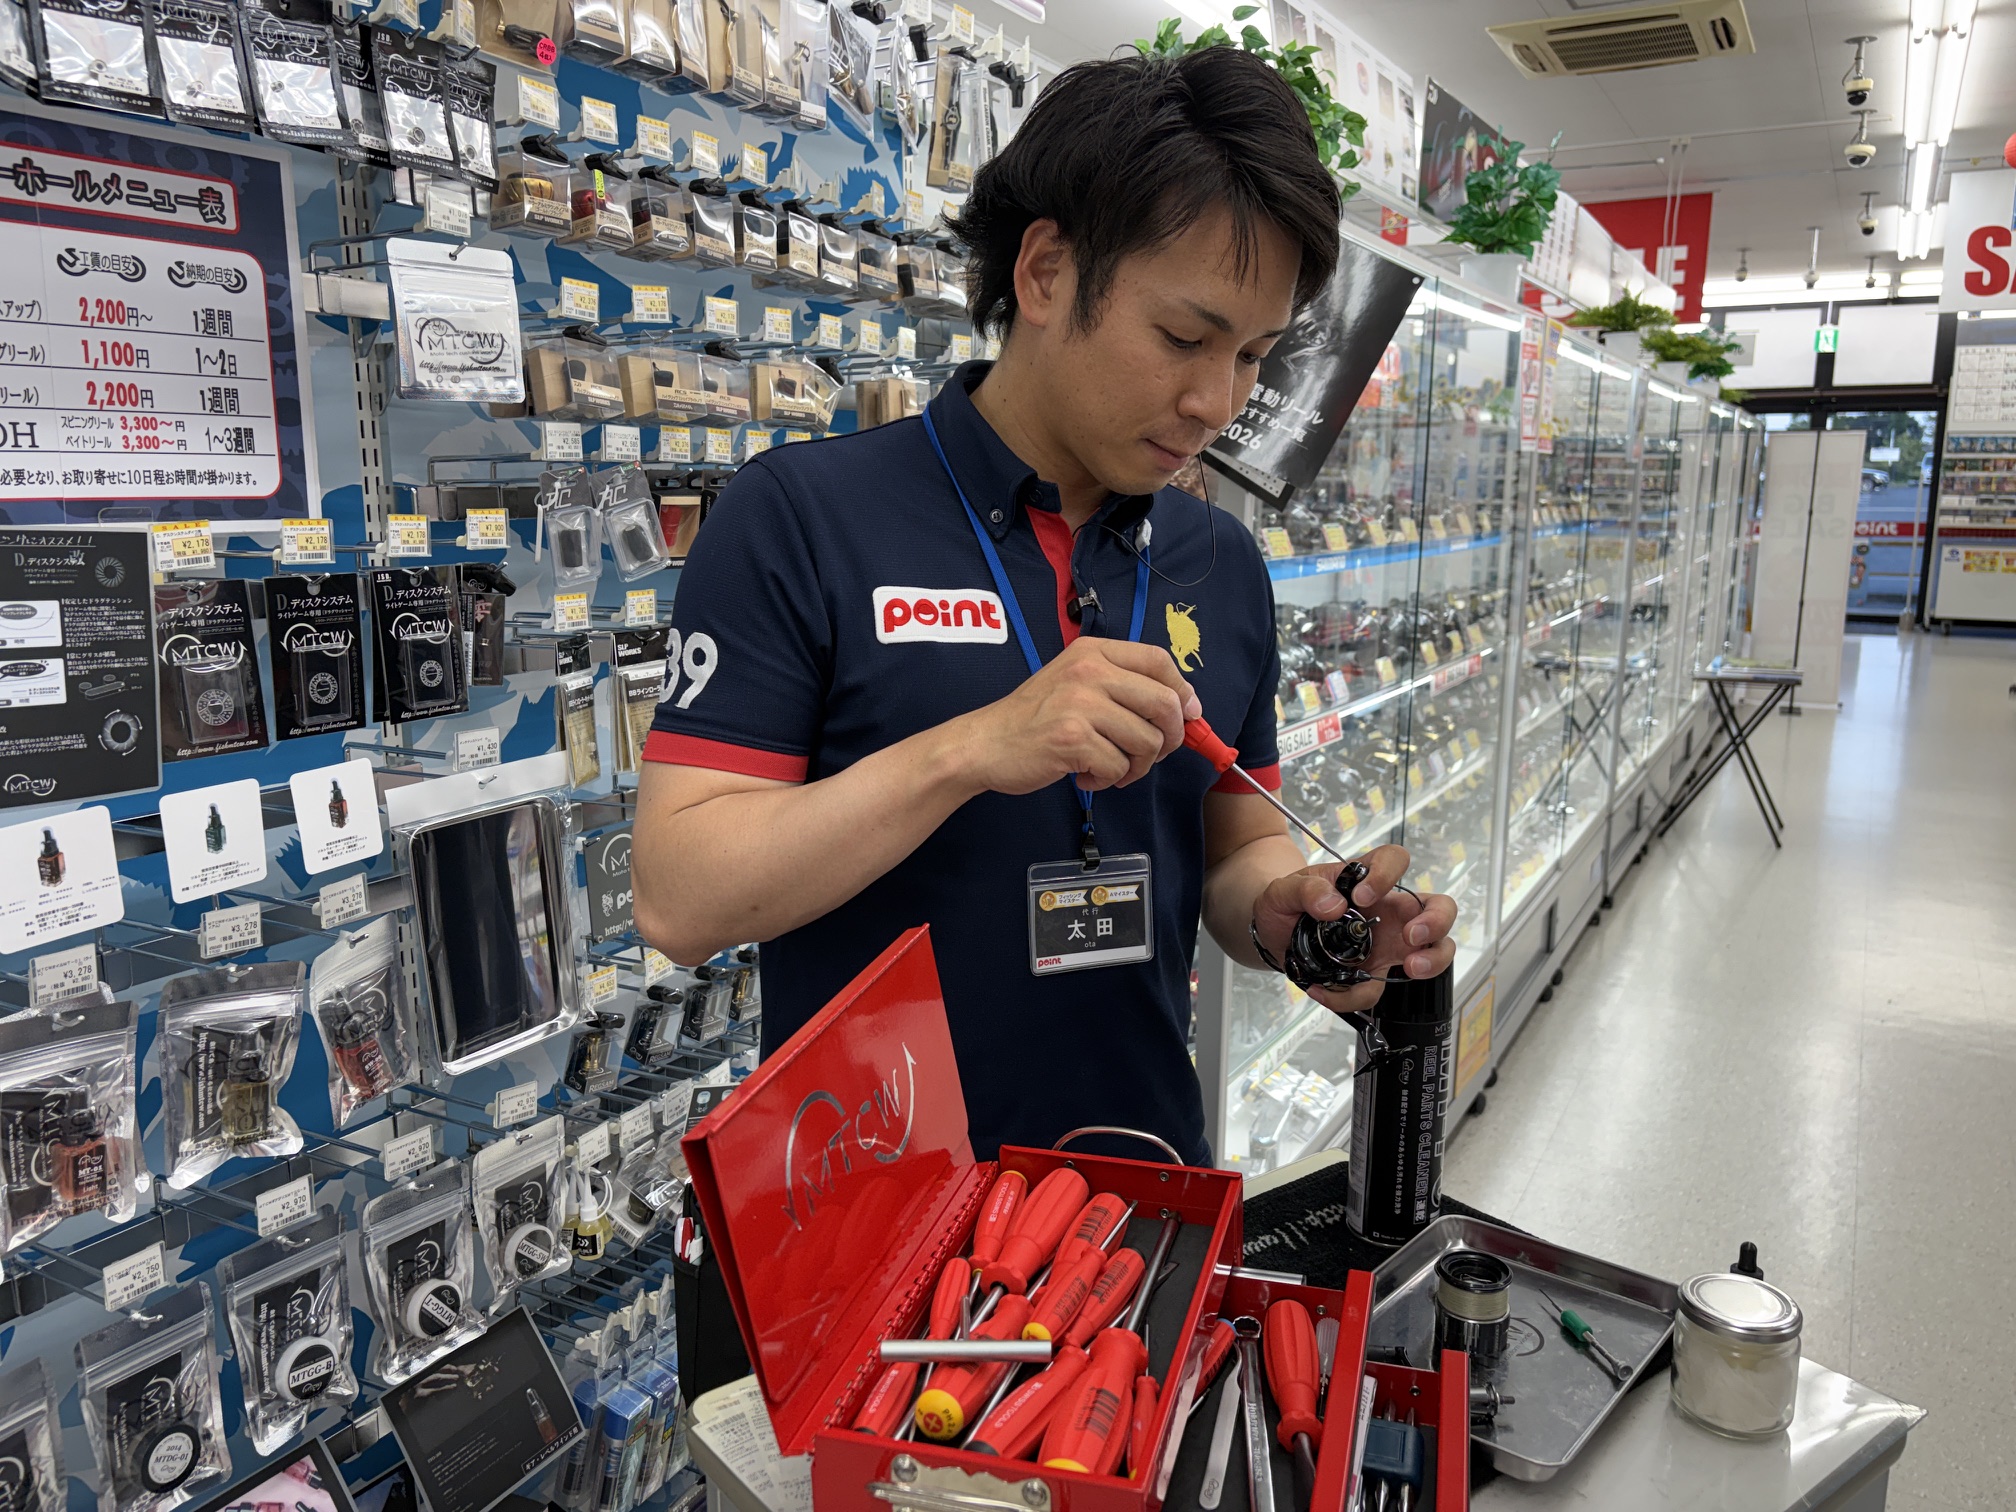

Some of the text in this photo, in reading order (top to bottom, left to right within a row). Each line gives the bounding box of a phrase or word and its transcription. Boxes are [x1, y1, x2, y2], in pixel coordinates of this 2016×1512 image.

[338, 52, 365, 69] TCW
[391, 64, 428, 81] MTCW
[544, 216, 564, 226] WORKS
[79, 250, 133, 274] 工賃の目安
[185, 262, 234, 285] 納期の目安
[0, 299, 42, 321] アップ)
[192, 307, 234, 338] 1週間
[81, 339, 150, 369] 1,100円
[86, 380, 154, 410] 2,200円
[200, 388, 241, 415] 1週間
[1249, 382, 1324, 425] 電動リール
[61, 416, 114, 430] スピニングリール
[174, 420, 186, 432] 円
[66, 435, 112, 449] ベイトリール
[177, 439, 188, 451] 円
[161, 522, 201, 531] SALE
[181, 538, 210, 549] ¥2,178
[305, 536, 328, 545] ¥2,178
[167, 602, 243, 619] ディスクシステム
[277, 609, 321, 620] ライトゲーム専用
[884, 597, 1001, 633] point
[398, 618, 446, 637] MTCW
[291, 629, 346, 650] MTCW
[617, 643, 629, 651] SLP
[171, 641, 236, 663] MTCW
[617, 647, 642, 658] WORKS
[1293, 728, 1313, 750] SALE
[10, 777, 52, 793] MTCW
[231, 921, 258, 932] ¥3,278
[1084, 940, 1096, 948] ota
[1037, 957, 1062, 968] point
[63, 965, 93, 979] ¥3,278
[1422, 1045, 1438, 1082] REEL
[1419, 1083, 1436, 1131] PARTS
[1414, 1132, 1433, 1197] CLEANER
[281, 1195, 307, 1211] ¥2,970
[132, 1262, 160, 1281] ¥2,750
[424, 1296, 457, 1324] MTGG-T
[290, 1359, 332, 1385] MTGG-B
[153, 1453, 189, 1464] MTDG-01
